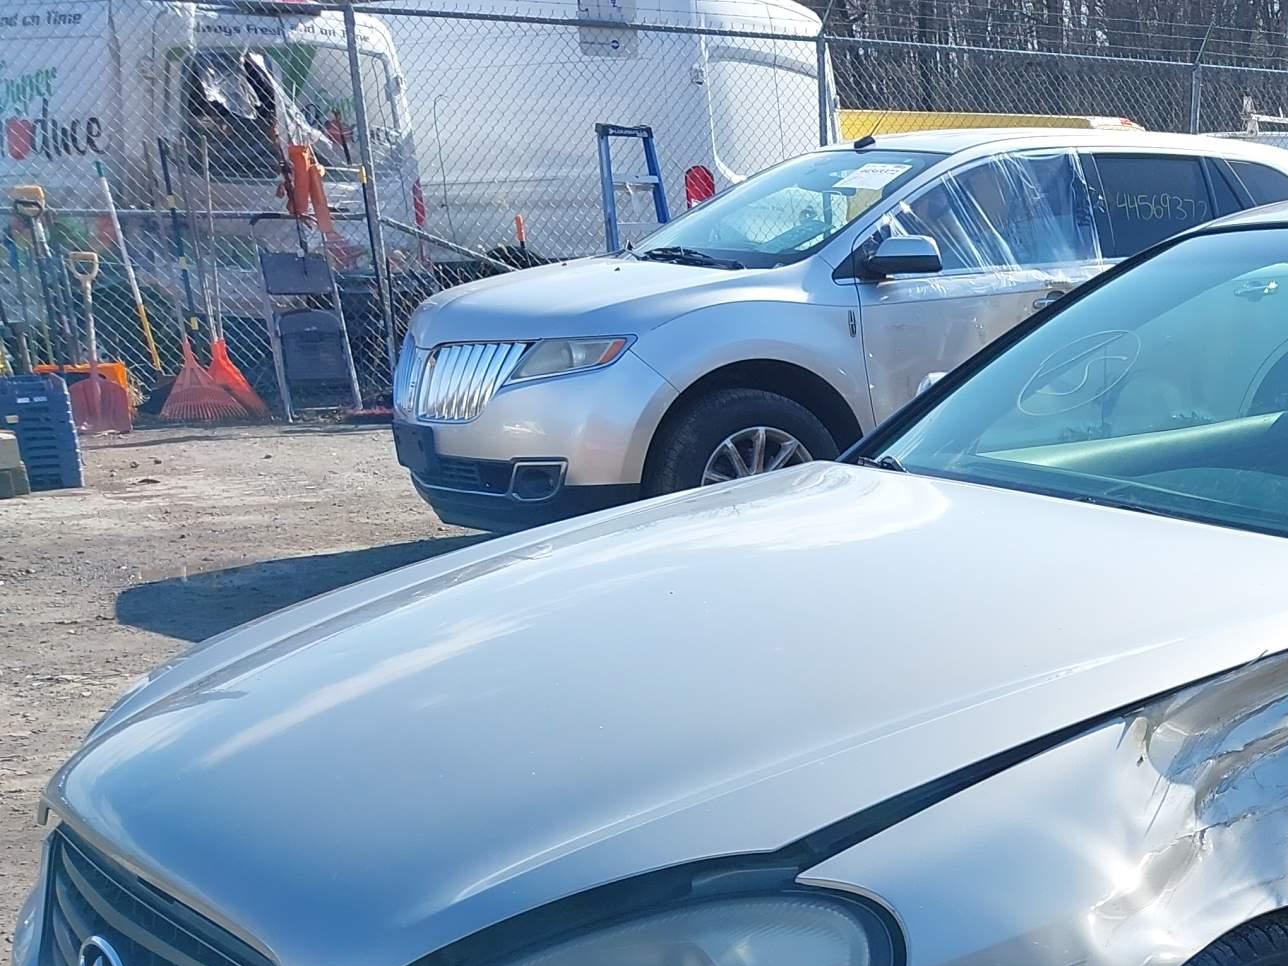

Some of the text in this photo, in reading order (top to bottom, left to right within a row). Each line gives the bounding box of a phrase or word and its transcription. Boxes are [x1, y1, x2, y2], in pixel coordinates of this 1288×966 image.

[0, 10, 82, 27] nd on Time
[194, 22, 240, 36] lways
